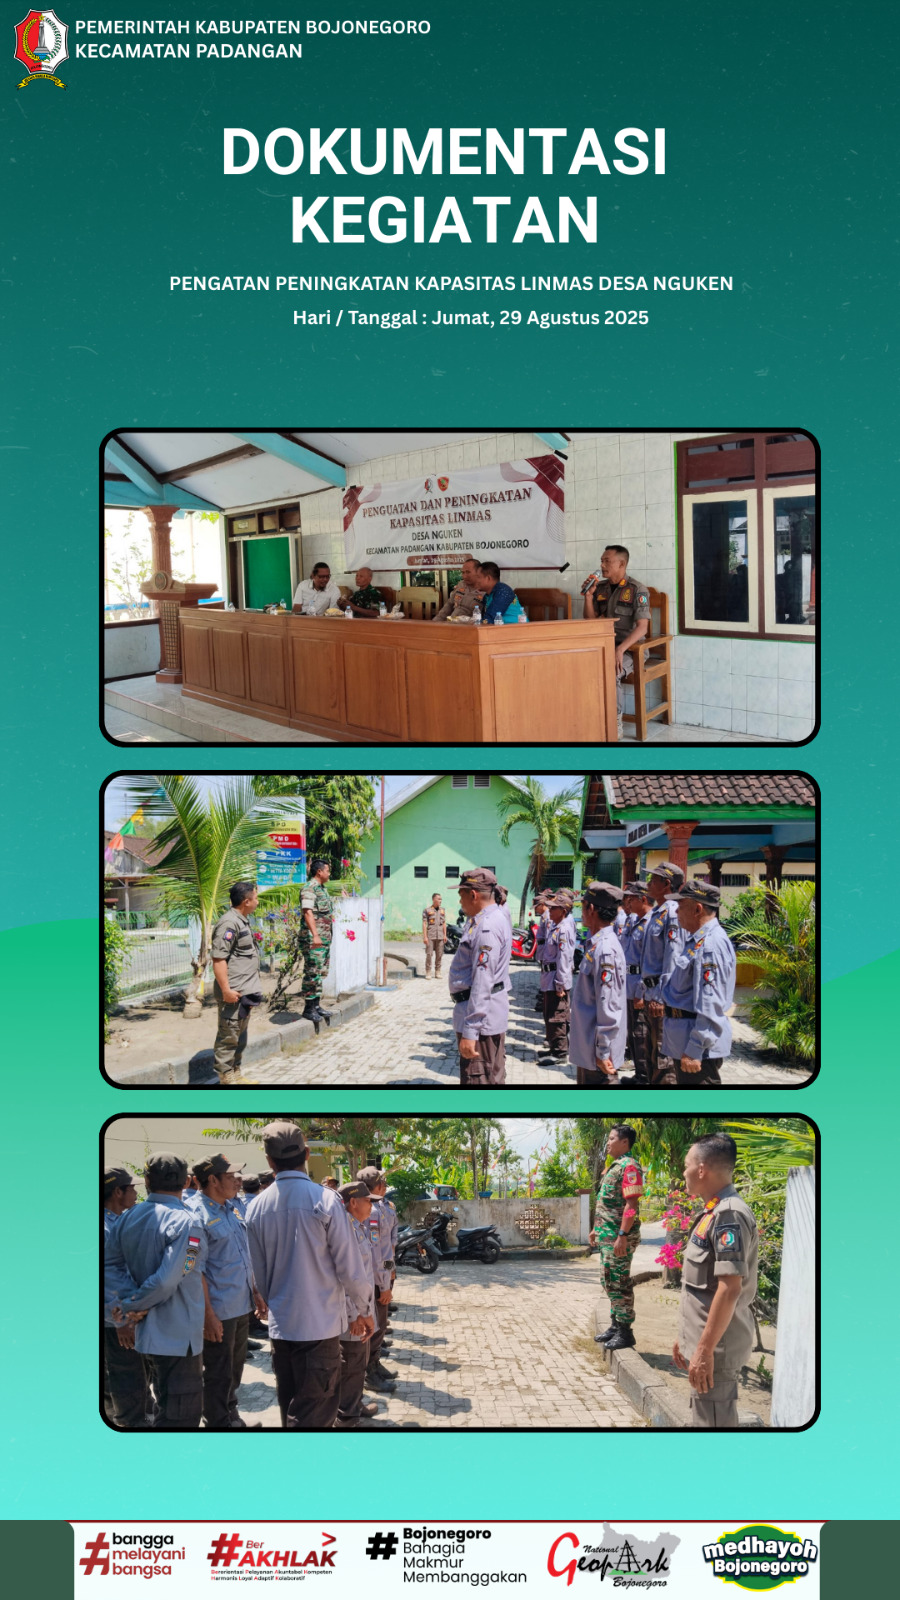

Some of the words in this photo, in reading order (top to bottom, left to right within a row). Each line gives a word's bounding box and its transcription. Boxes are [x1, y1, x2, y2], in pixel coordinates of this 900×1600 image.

[363, 501, 417, 517] PENGUATAN
[420, 498, 442, 510] DAN
[444, 487, 532, 507] PENINGKATAN
[390, 513, 445, 529] KAPASITAS
[448, 509, 492, 523] LINMAS
[412, 531, 430, 541] DESA
[431, 529, 463, 540] NGUKEN
[366, 545, 399, 555] KECAMATAN
[400, 544, 435, 553] PADANGAN
[436, 541, 474, 551] KABUPATEN
[476, 538, 530, 549] BOJONEGORO
